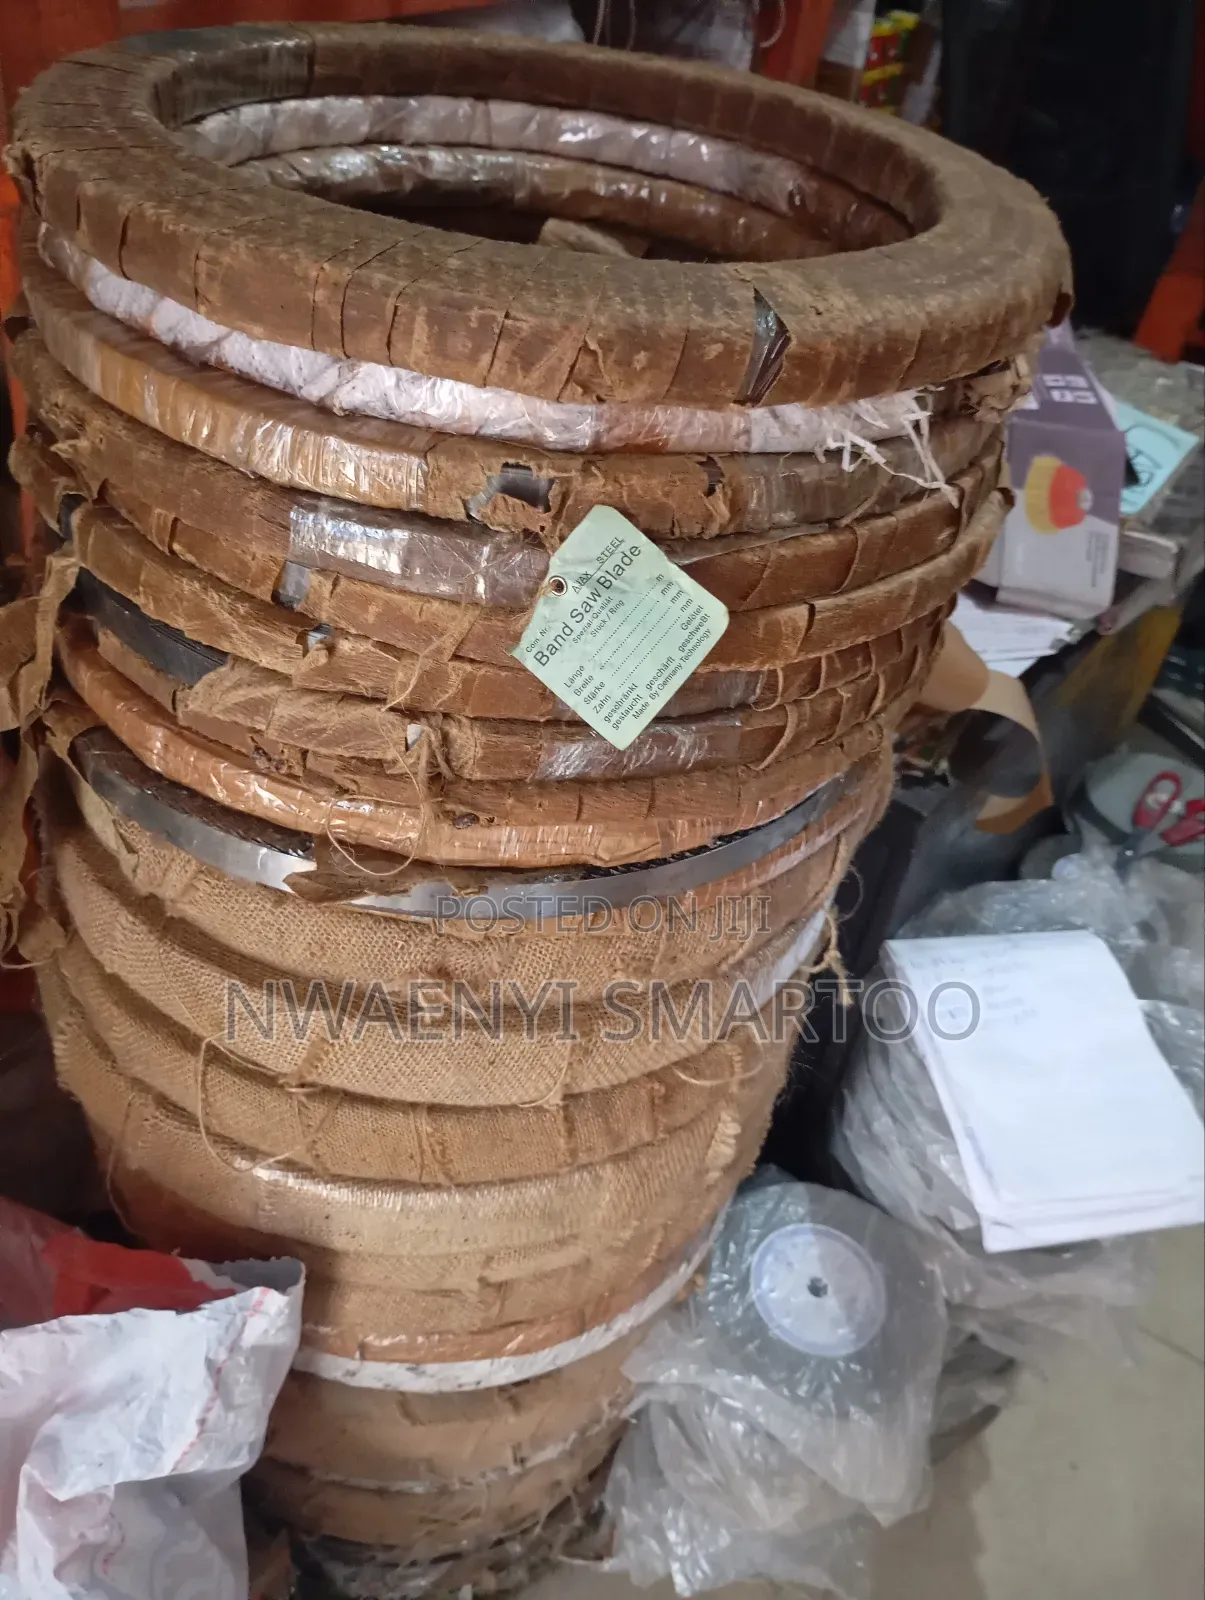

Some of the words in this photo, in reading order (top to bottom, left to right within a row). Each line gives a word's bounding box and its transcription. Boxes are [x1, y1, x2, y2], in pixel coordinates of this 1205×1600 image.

[596, 537, 625, 564] STEEL
[525, 637, 540, 653] Com
[533, 622, 574, 667] Band
[570, 588, 602, 624] Saw
[596, 545, 641, 590] Blade
[563, 665, 585, 689] Länge
[655, 573, 665, 582] m
[573, 674, 594, 697] Breite
[660, 580, 674, 596] mm
[583, 681, 606, 705] Stärke
[670, 589, 684, 605] mm
[608, 600, 625, 616] Ring
[680, 604, 704, 631] Gelötet
[592, 694, 612, 714] Zahn
[680, 598, 694, 613] mm
[611, 694, 644, 731] gestaucht
[645, 655, 676, 691] geschärft
[631, 701, 650, 720] Made
[649, 690, 660, 701] By
[657, 662, 683, 691] Germany
[680, 628, 712, 664] Technology
[603, 682, 639, 724] geschränkt
